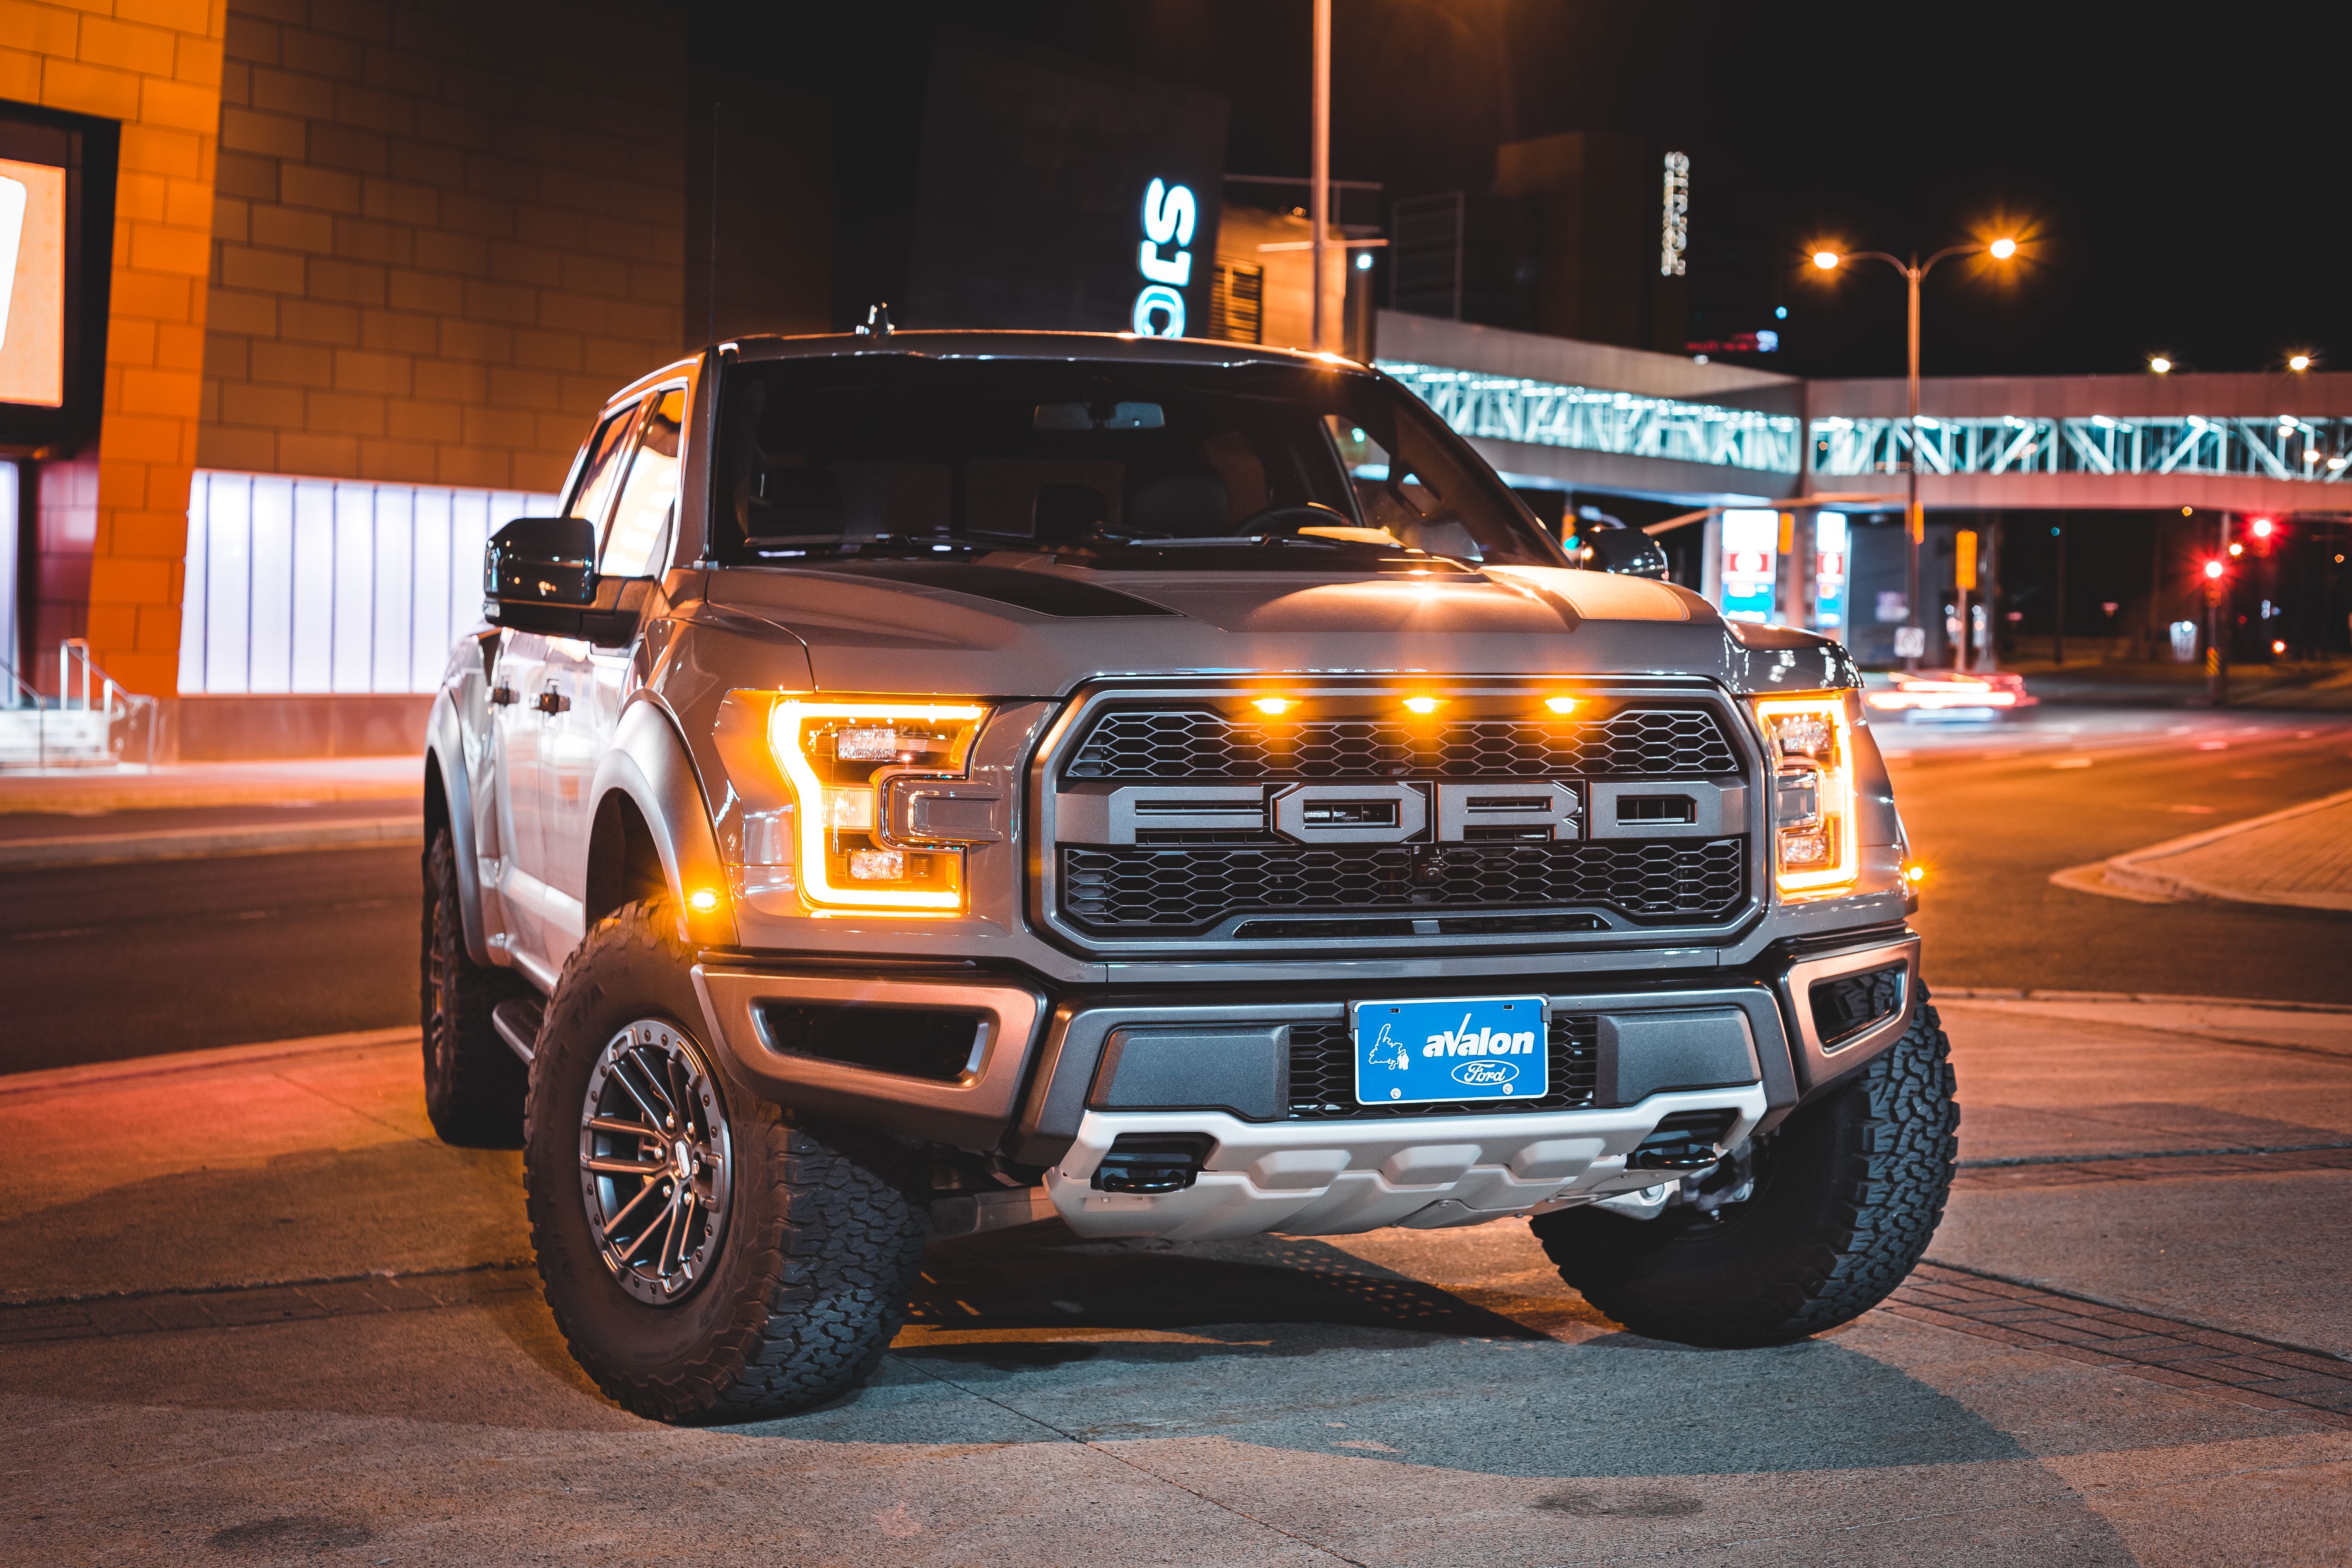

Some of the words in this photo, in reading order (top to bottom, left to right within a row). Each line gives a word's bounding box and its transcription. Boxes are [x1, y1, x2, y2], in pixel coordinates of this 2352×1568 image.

[1109, 781, 1720, 844] FORD
[1423, 1013, 1535, 1057] avalon
[1464, 1063, 1506, 1082] Ford
